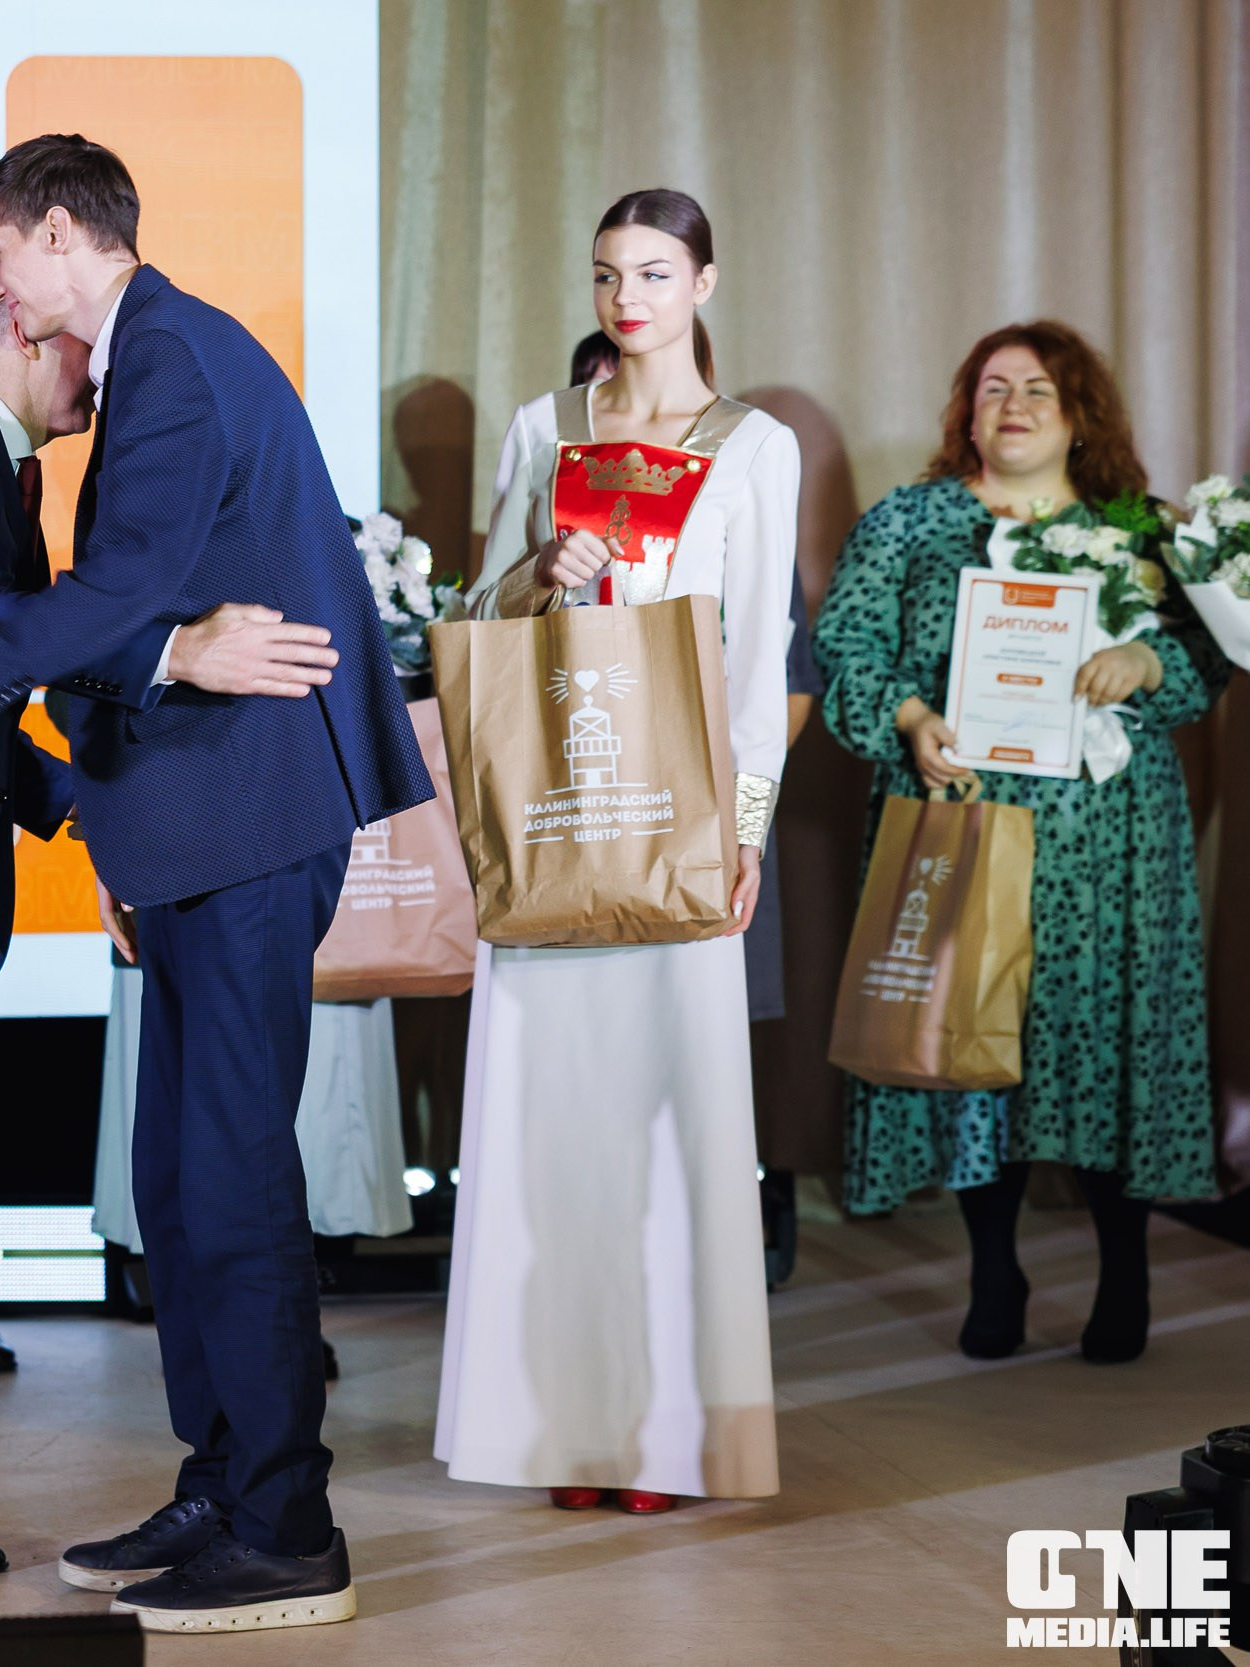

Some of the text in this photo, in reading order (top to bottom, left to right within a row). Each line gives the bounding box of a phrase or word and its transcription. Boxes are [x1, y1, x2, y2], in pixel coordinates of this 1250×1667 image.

[982, 615, 1070, 634] ДИПЛОМ
[524, 789, 673, 815] КАЛИНИНГРАДСКИЙ
[524, 806, 674, 832] ДОБРОВОЛЬЧЕСКИЙ
[574, 828, 622, 843] ЦЕНТР
